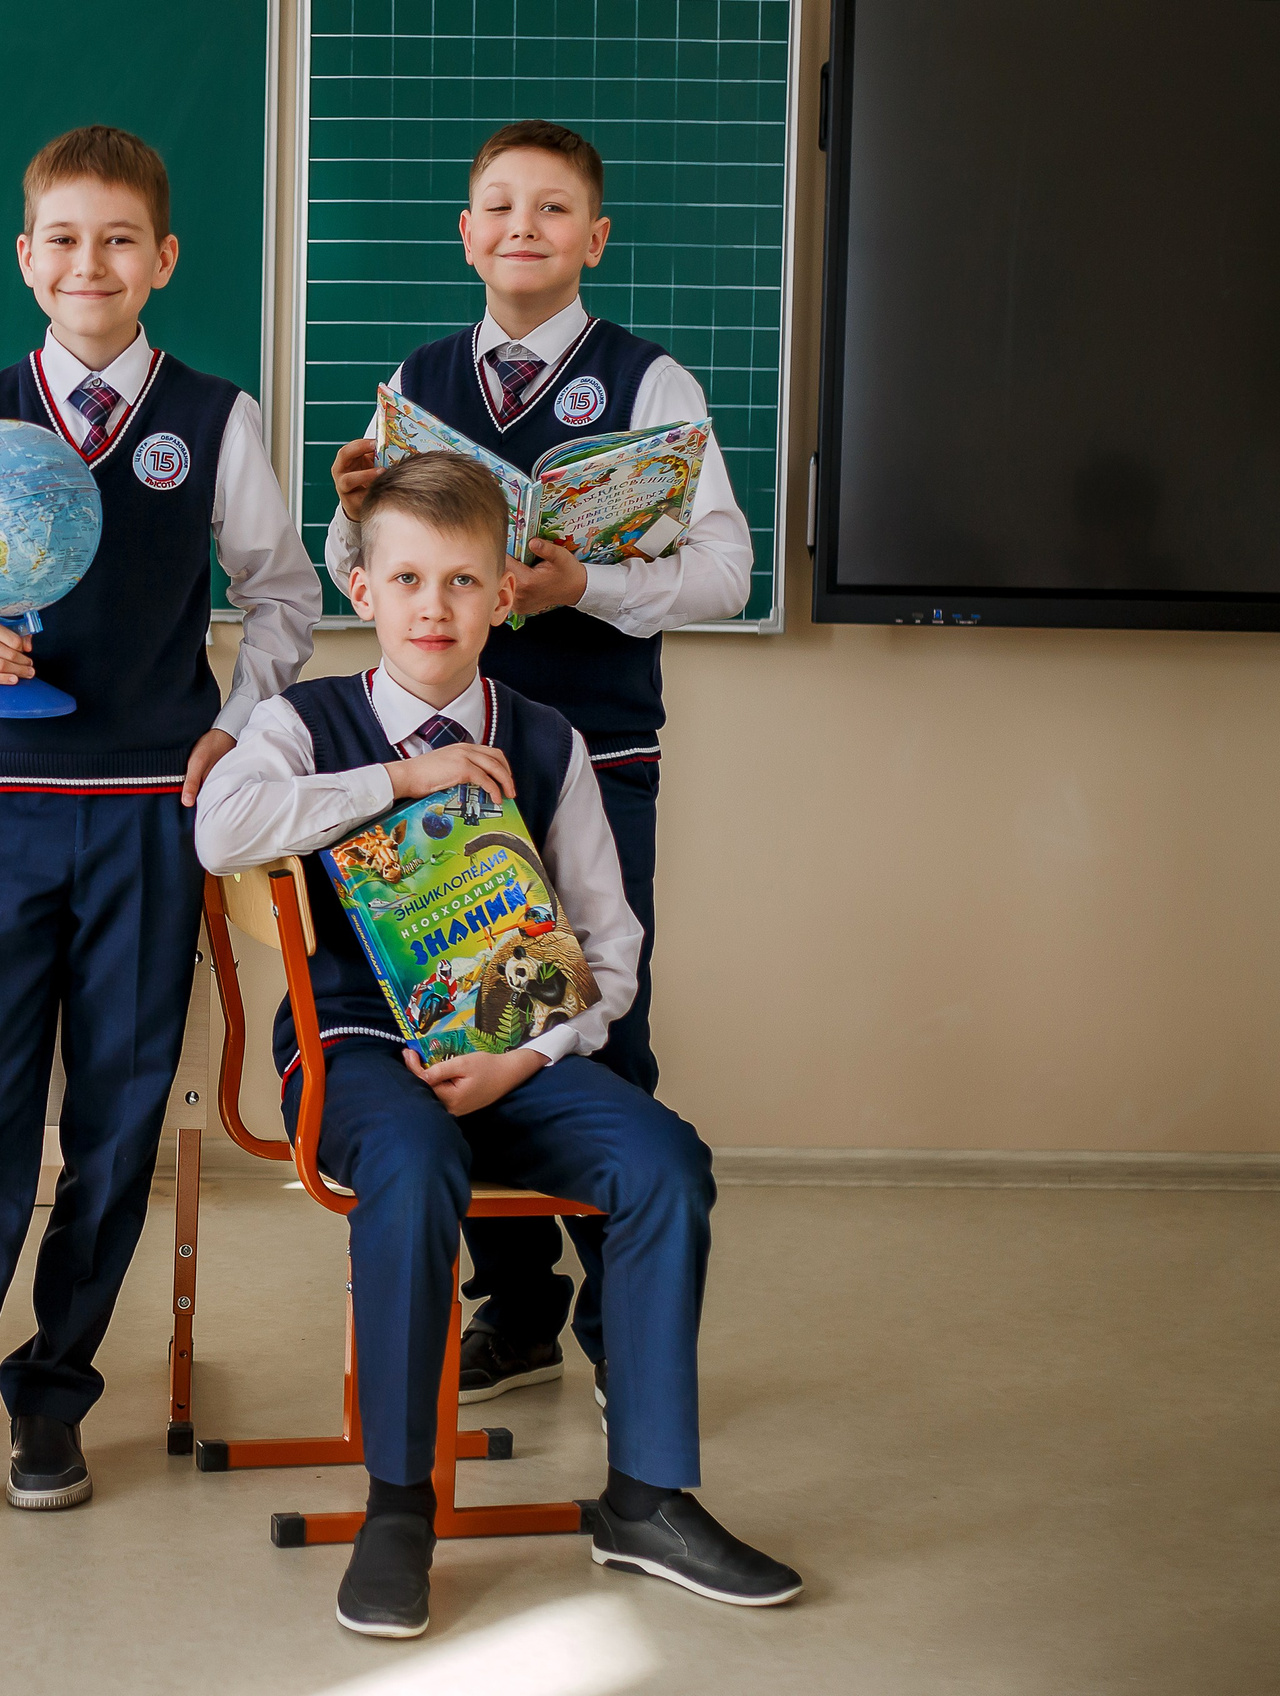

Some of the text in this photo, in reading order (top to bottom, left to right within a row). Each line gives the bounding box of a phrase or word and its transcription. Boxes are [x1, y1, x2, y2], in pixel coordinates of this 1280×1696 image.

[569, 392, 591, 410] 15
[145, 476, 177, 488] ВЫСОТА
[150, 450, 175, 472] 15
[570, 501, 653, 533] ЖИВОТНЫХ
[393, 849, 508, 921] ЭНЦИКЛОПЕДИЯ
[401, 867, 516, 939] НЕОБХОДИМЫХ
[351, 914, 382, 975] ЭНЦИКЛОПЕДИЯ
[410, 877, 527, 965] ЗНАНИЙ
[378, 979, 412, 1040] ЗНАНИЙ
